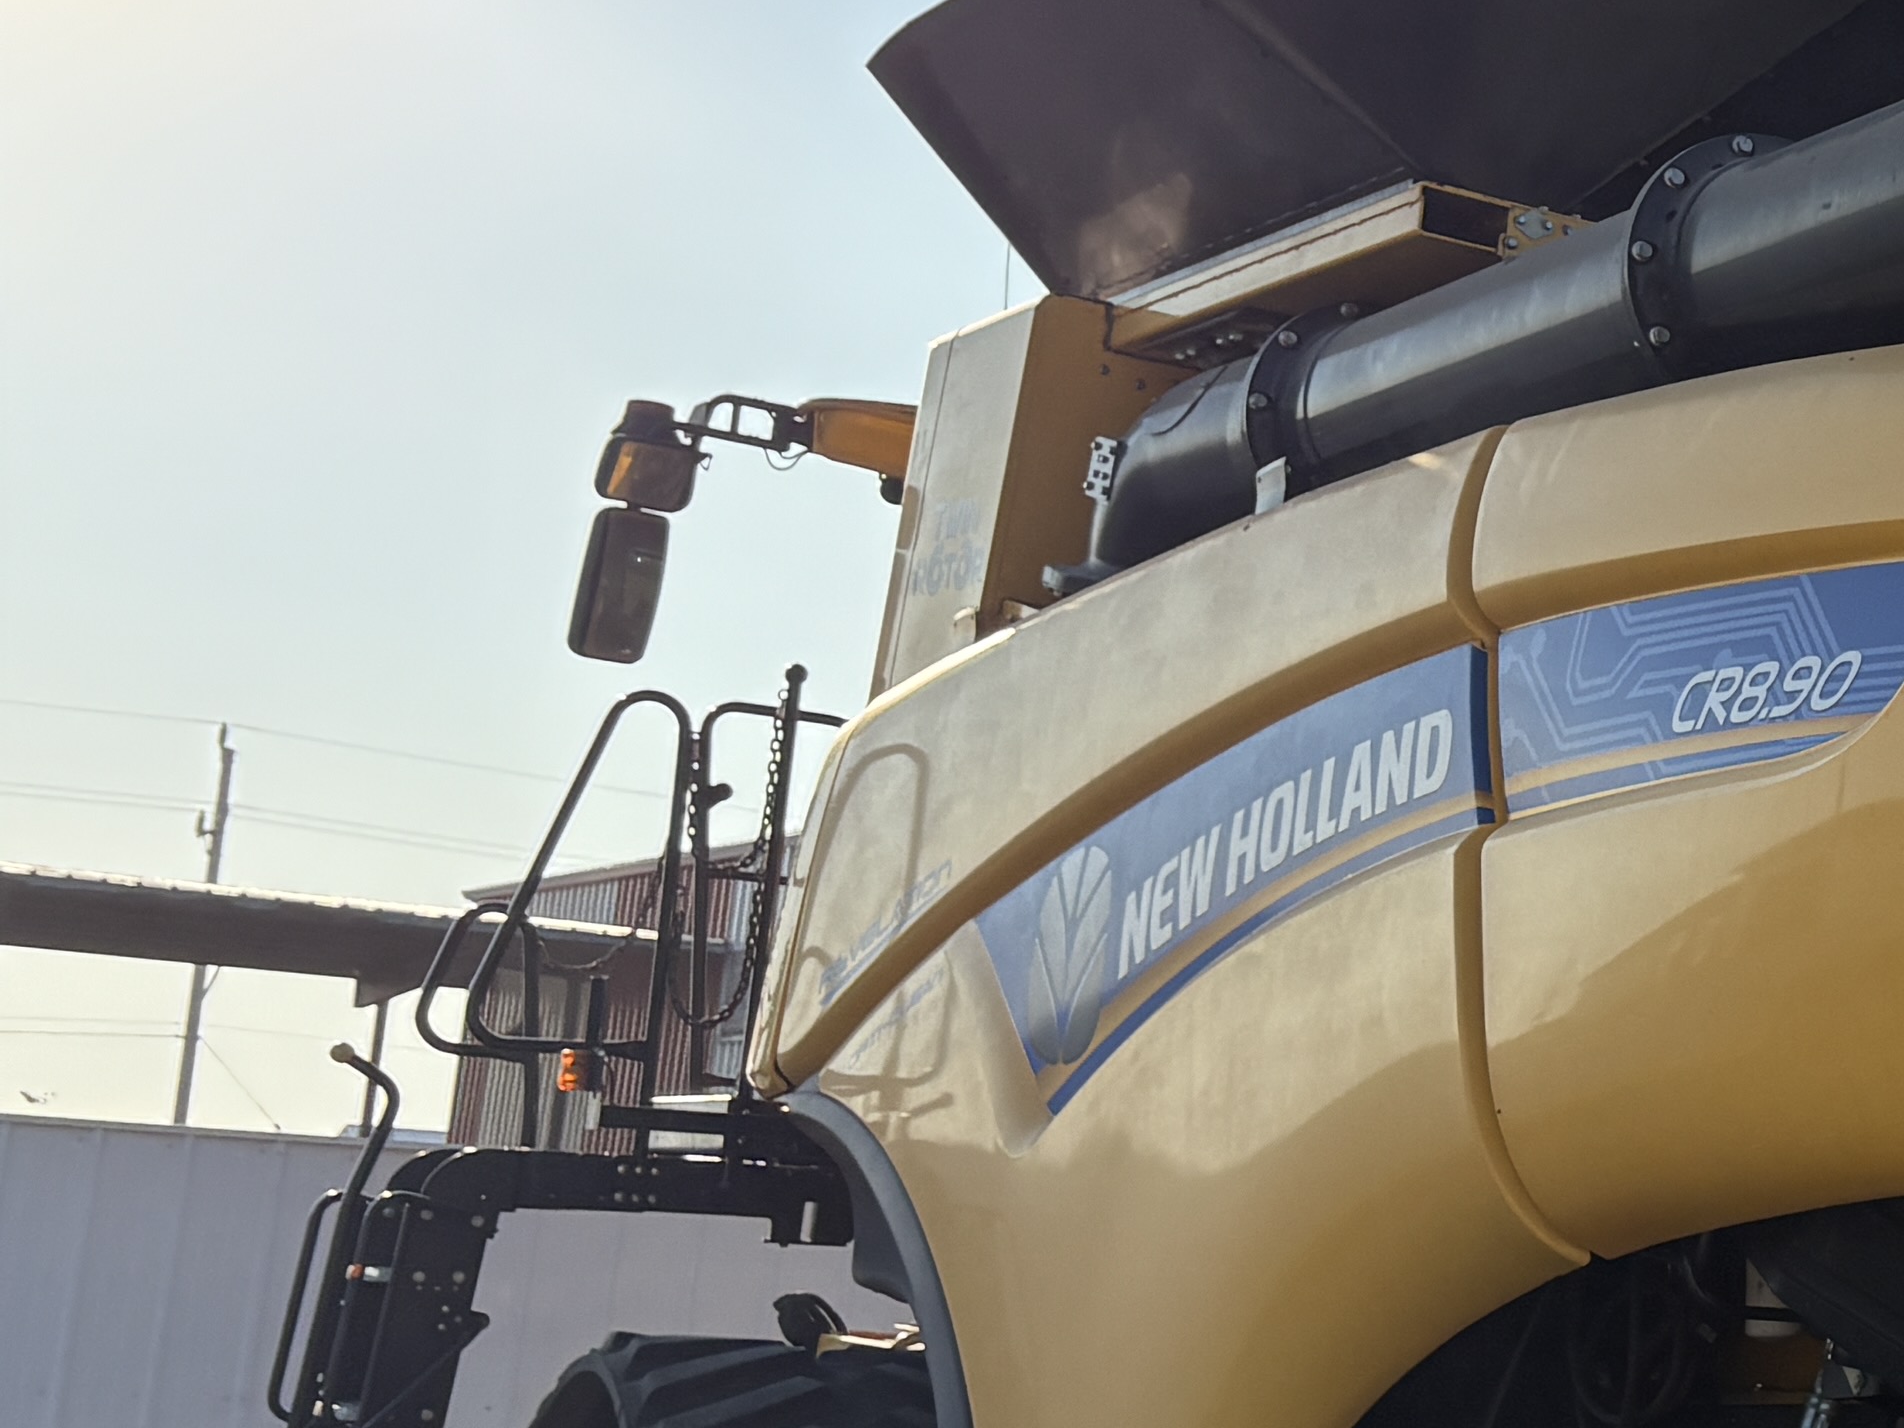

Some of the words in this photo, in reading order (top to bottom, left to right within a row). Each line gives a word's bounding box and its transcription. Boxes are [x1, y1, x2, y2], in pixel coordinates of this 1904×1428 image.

[1671, 650, 1862, 733] CR8.90
[1118, 824, 1222, 978] NEW
[1224, 709, 1454, 896] HOLLAND
